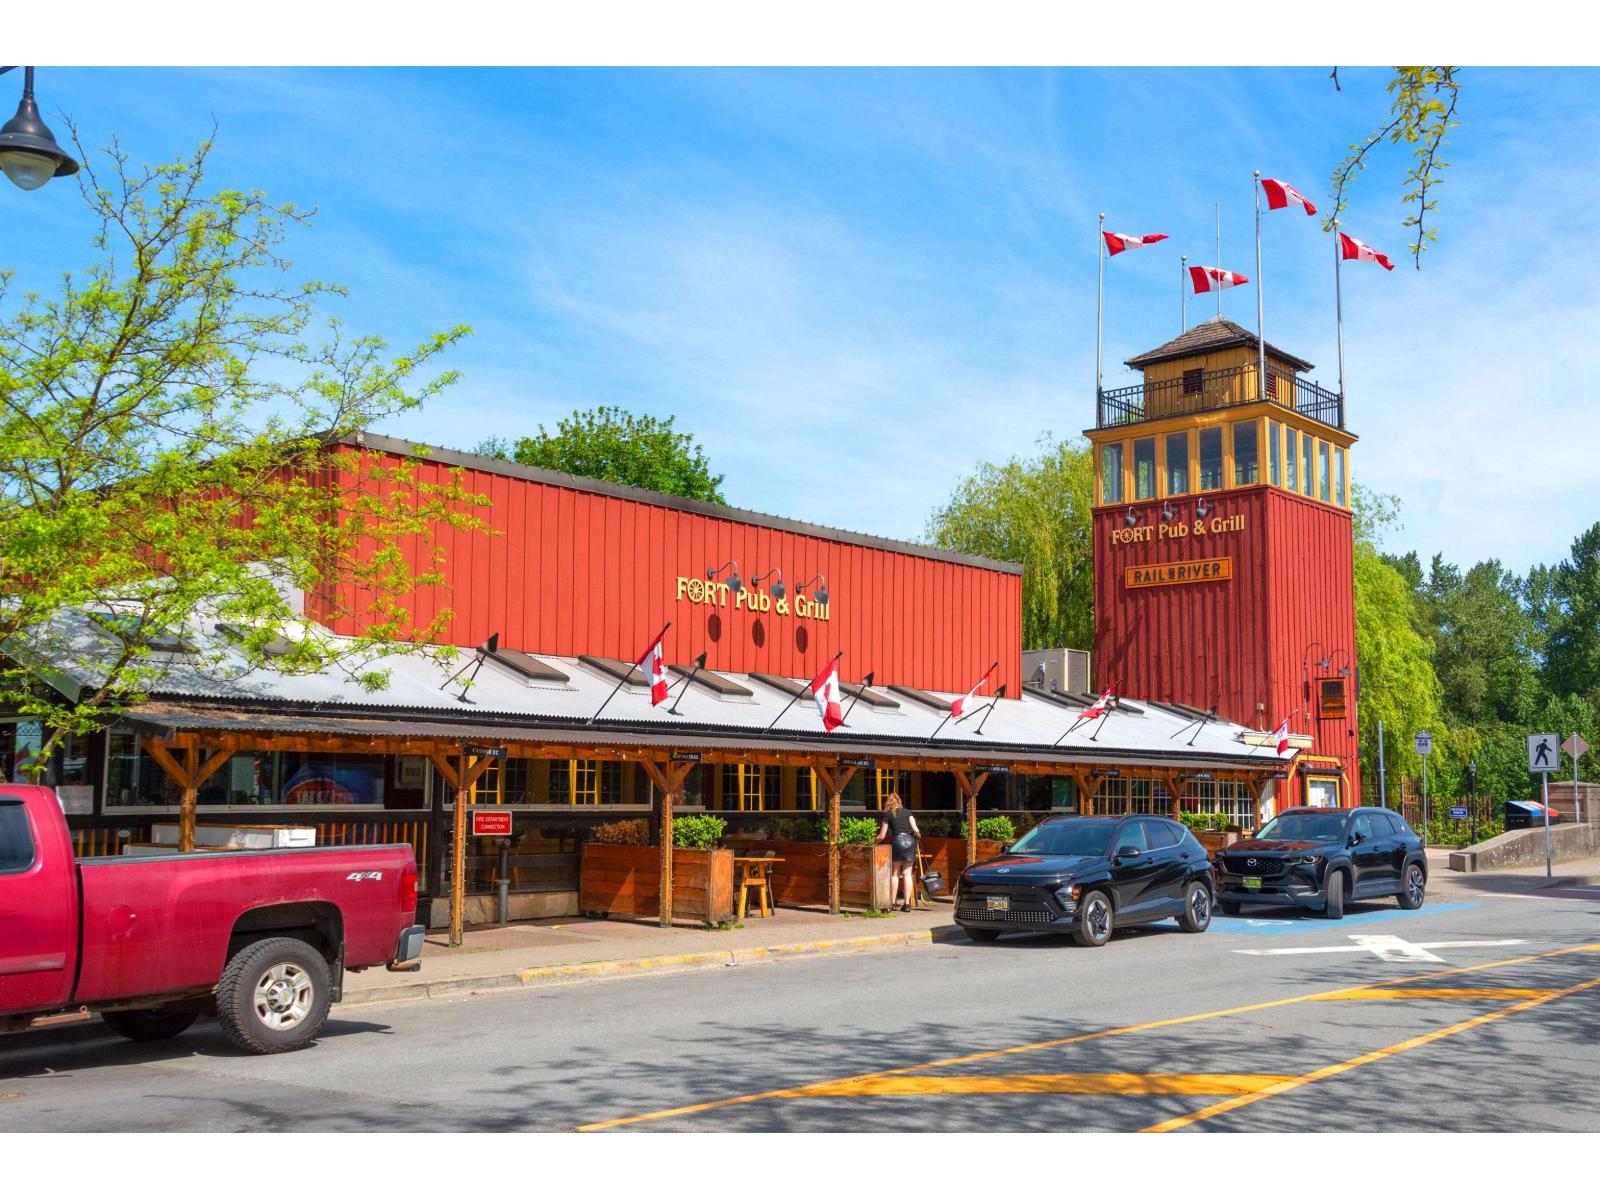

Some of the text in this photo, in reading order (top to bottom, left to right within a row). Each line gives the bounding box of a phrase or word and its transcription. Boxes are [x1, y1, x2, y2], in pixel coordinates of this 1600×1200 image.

[1112, 514, 1246, 545] FORT Pub & Grill
[1134, 569, 1166, 584] RAIL
[1178, 562, 1221, 579] RIVER
[676, 576, 830, 621] FORT Pub & Grill
